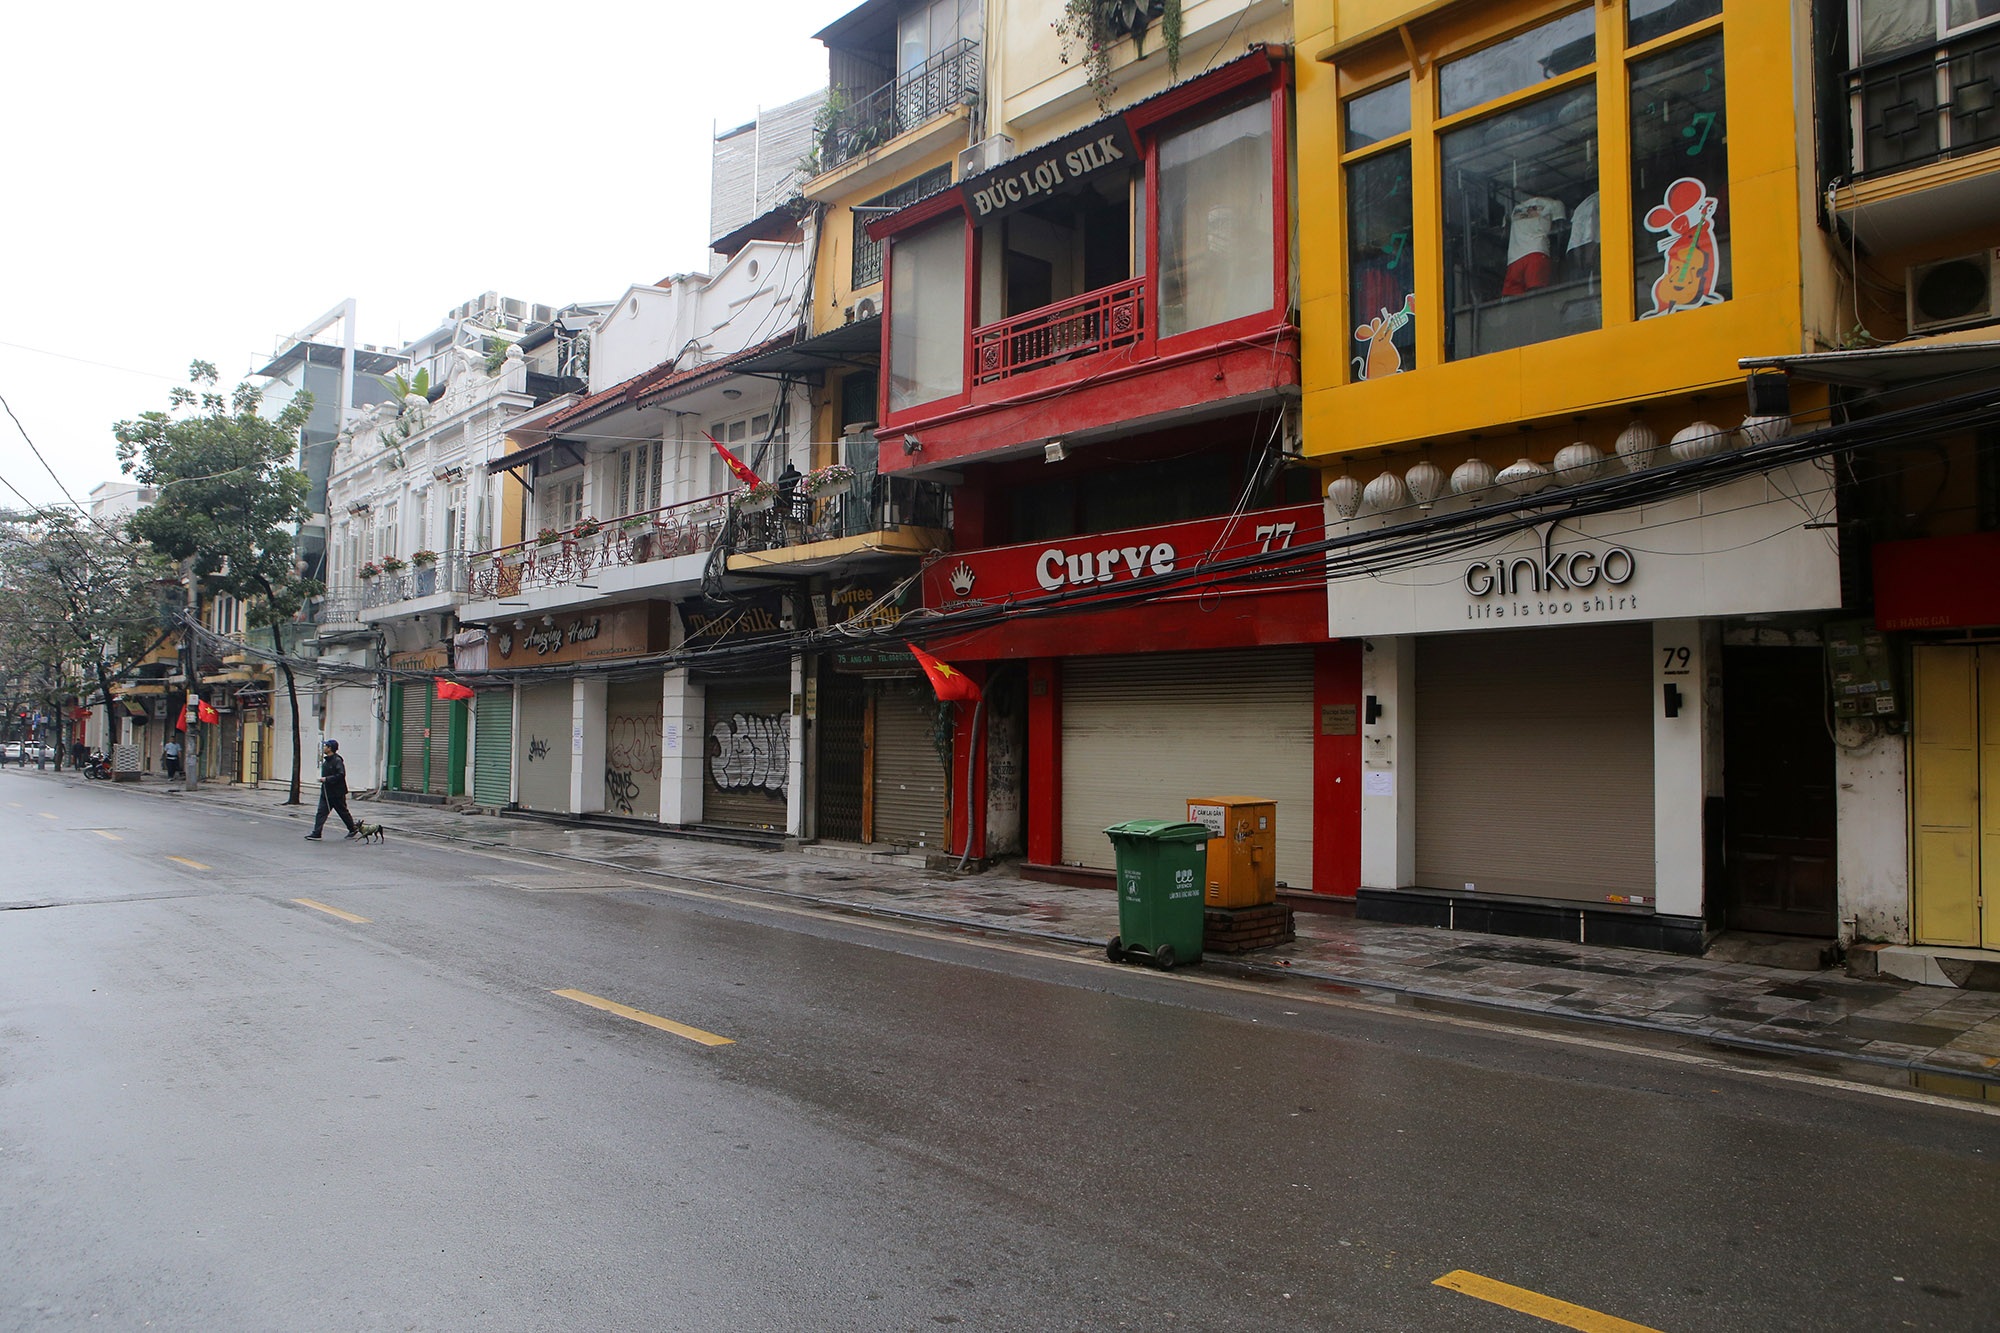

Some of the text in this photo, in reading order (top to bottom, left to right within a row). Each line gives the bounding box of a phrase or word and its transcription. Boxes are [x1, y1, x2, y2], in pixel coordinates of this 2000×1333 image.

[973, 134, 1124, 216] ĐỨC LỢI SILK
[1256, 521, 1296, 554] 77
[1036, 542, 1175, 591] Curve
[740, 607, 777, 633] silk
[1468, 595, 1637, 619] life is too shirt
[523, 626, 562, 655] Amazing
[567, 619, 598, 643] Hanoi
[838, 654, 847, 663] 75
[1663, 646, 1690, 669] 79
